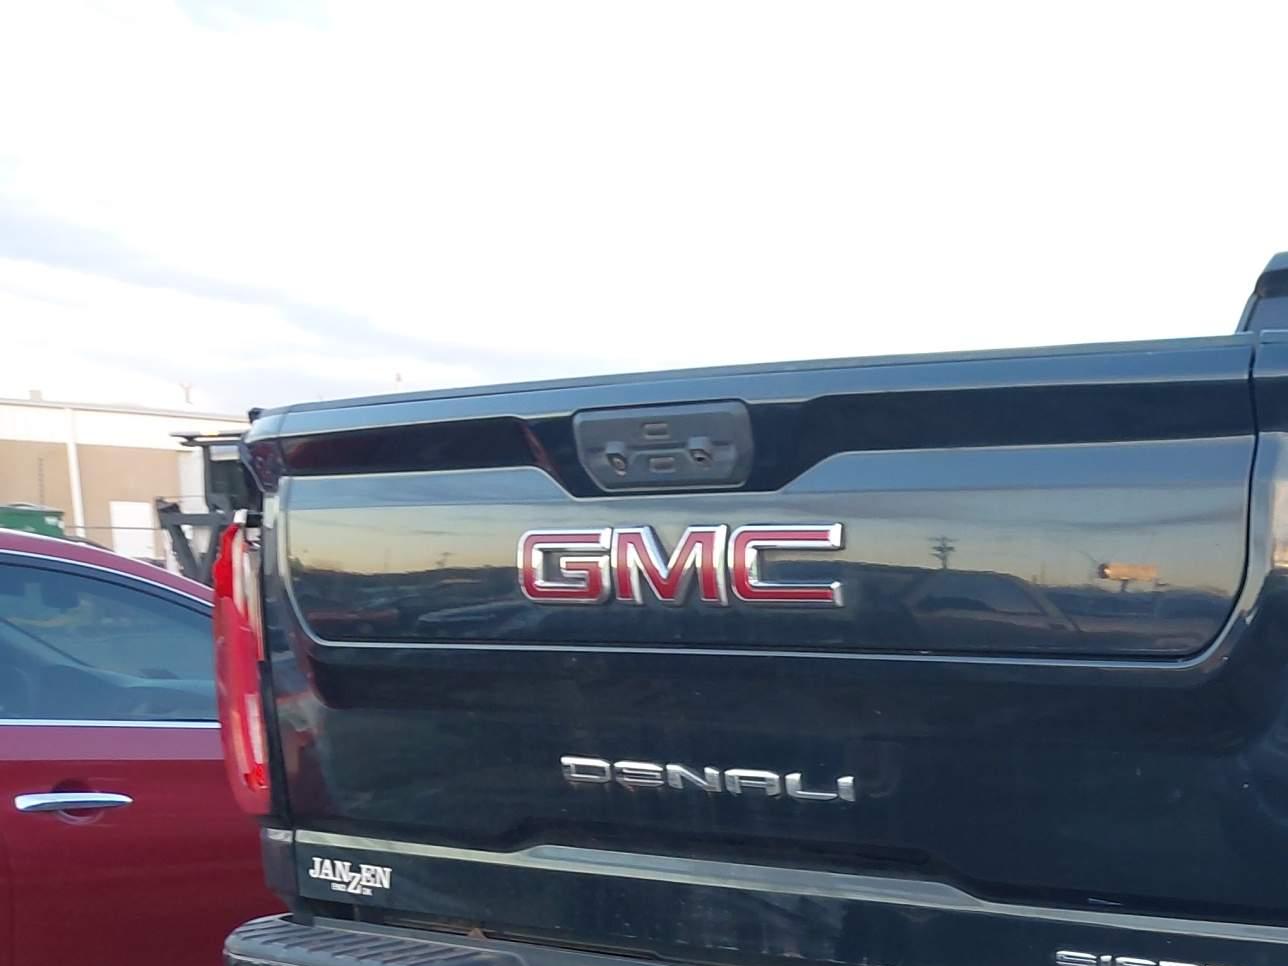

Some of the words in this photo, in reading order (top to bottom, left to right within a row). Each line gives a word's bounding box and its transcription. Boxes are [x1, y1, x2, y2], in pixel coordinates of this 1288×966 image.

[517, 522, 846, 607] GMC
[560, 755, 856, 802] DENALI
[308, 856, 393, 894] JANZEN
